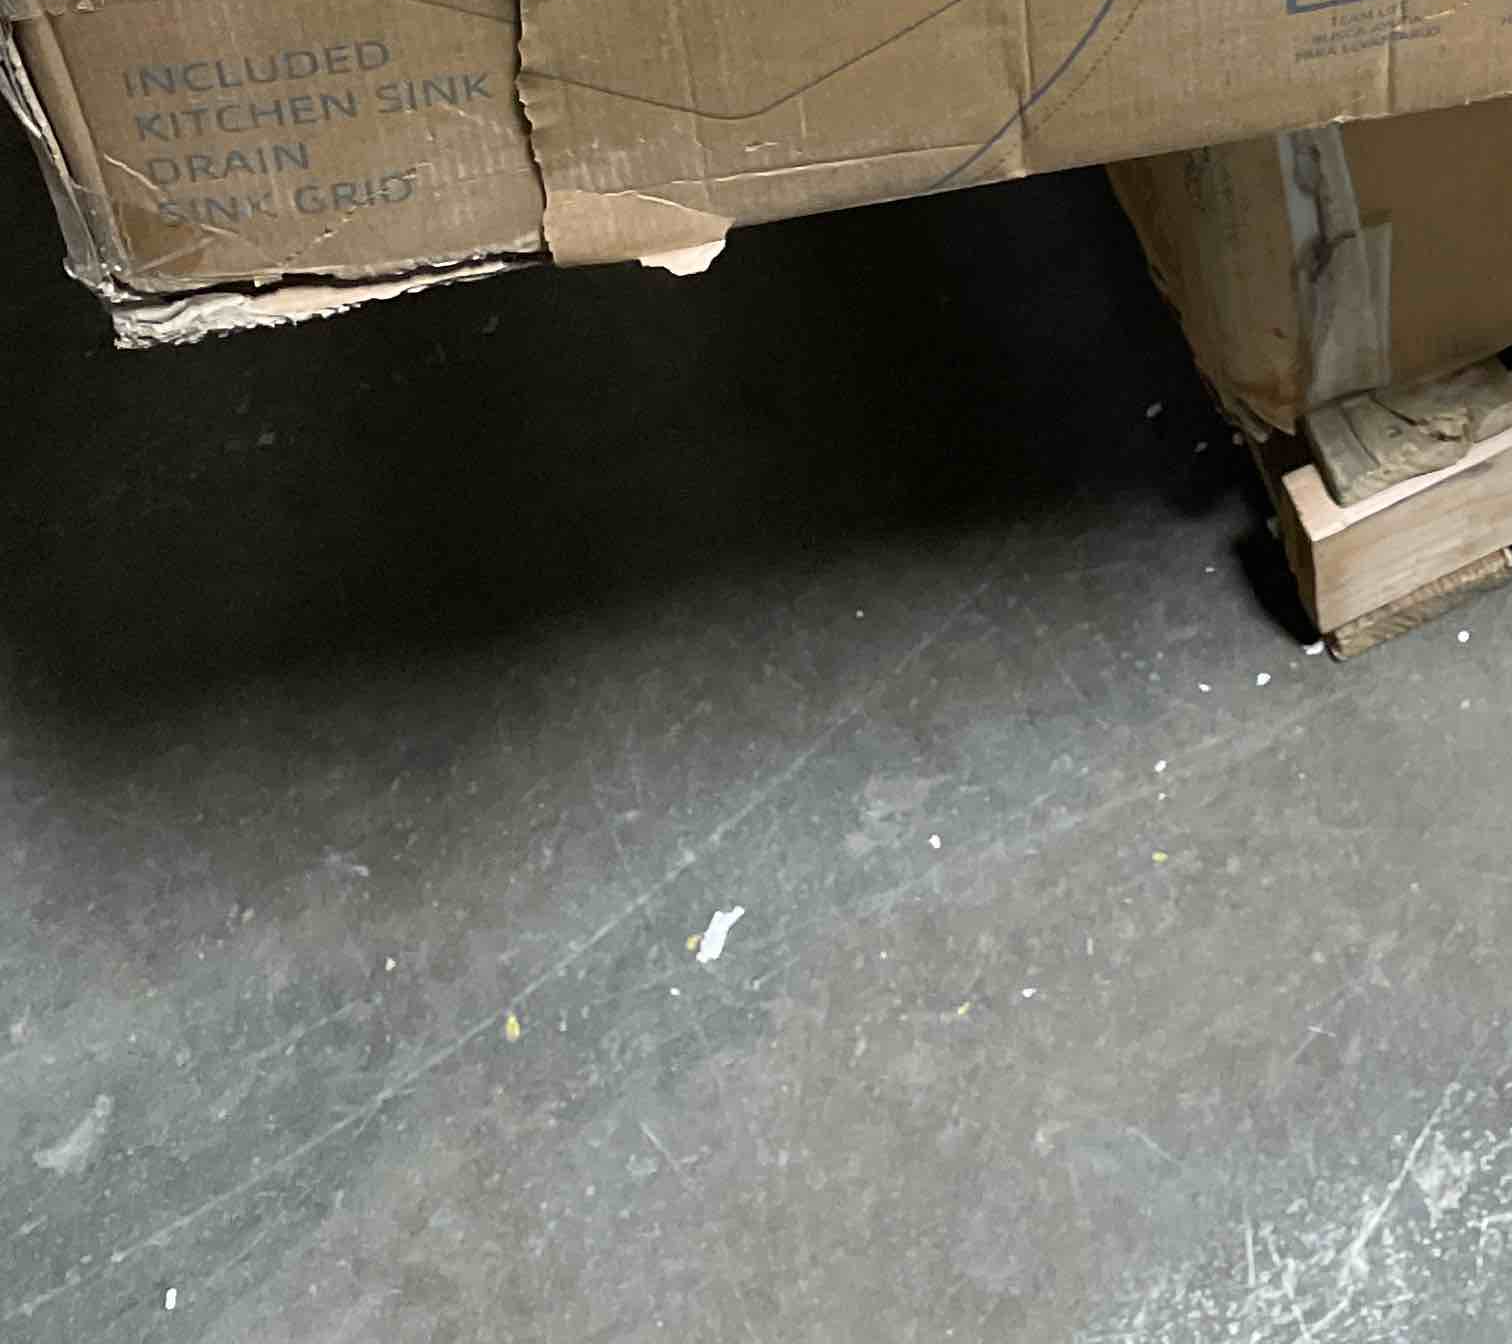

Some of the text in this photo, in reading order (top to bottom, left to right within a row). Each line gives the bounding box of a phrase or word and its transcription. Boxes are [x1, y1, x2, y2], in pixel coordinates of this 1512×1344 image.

[123, 39, 391, 99] INCLUDED
[133, 71, 492, 143] KITCHEN SINK
[147, 141, 310, 187] DRAIN
[157, 167, 415, 229] SINK GRID
